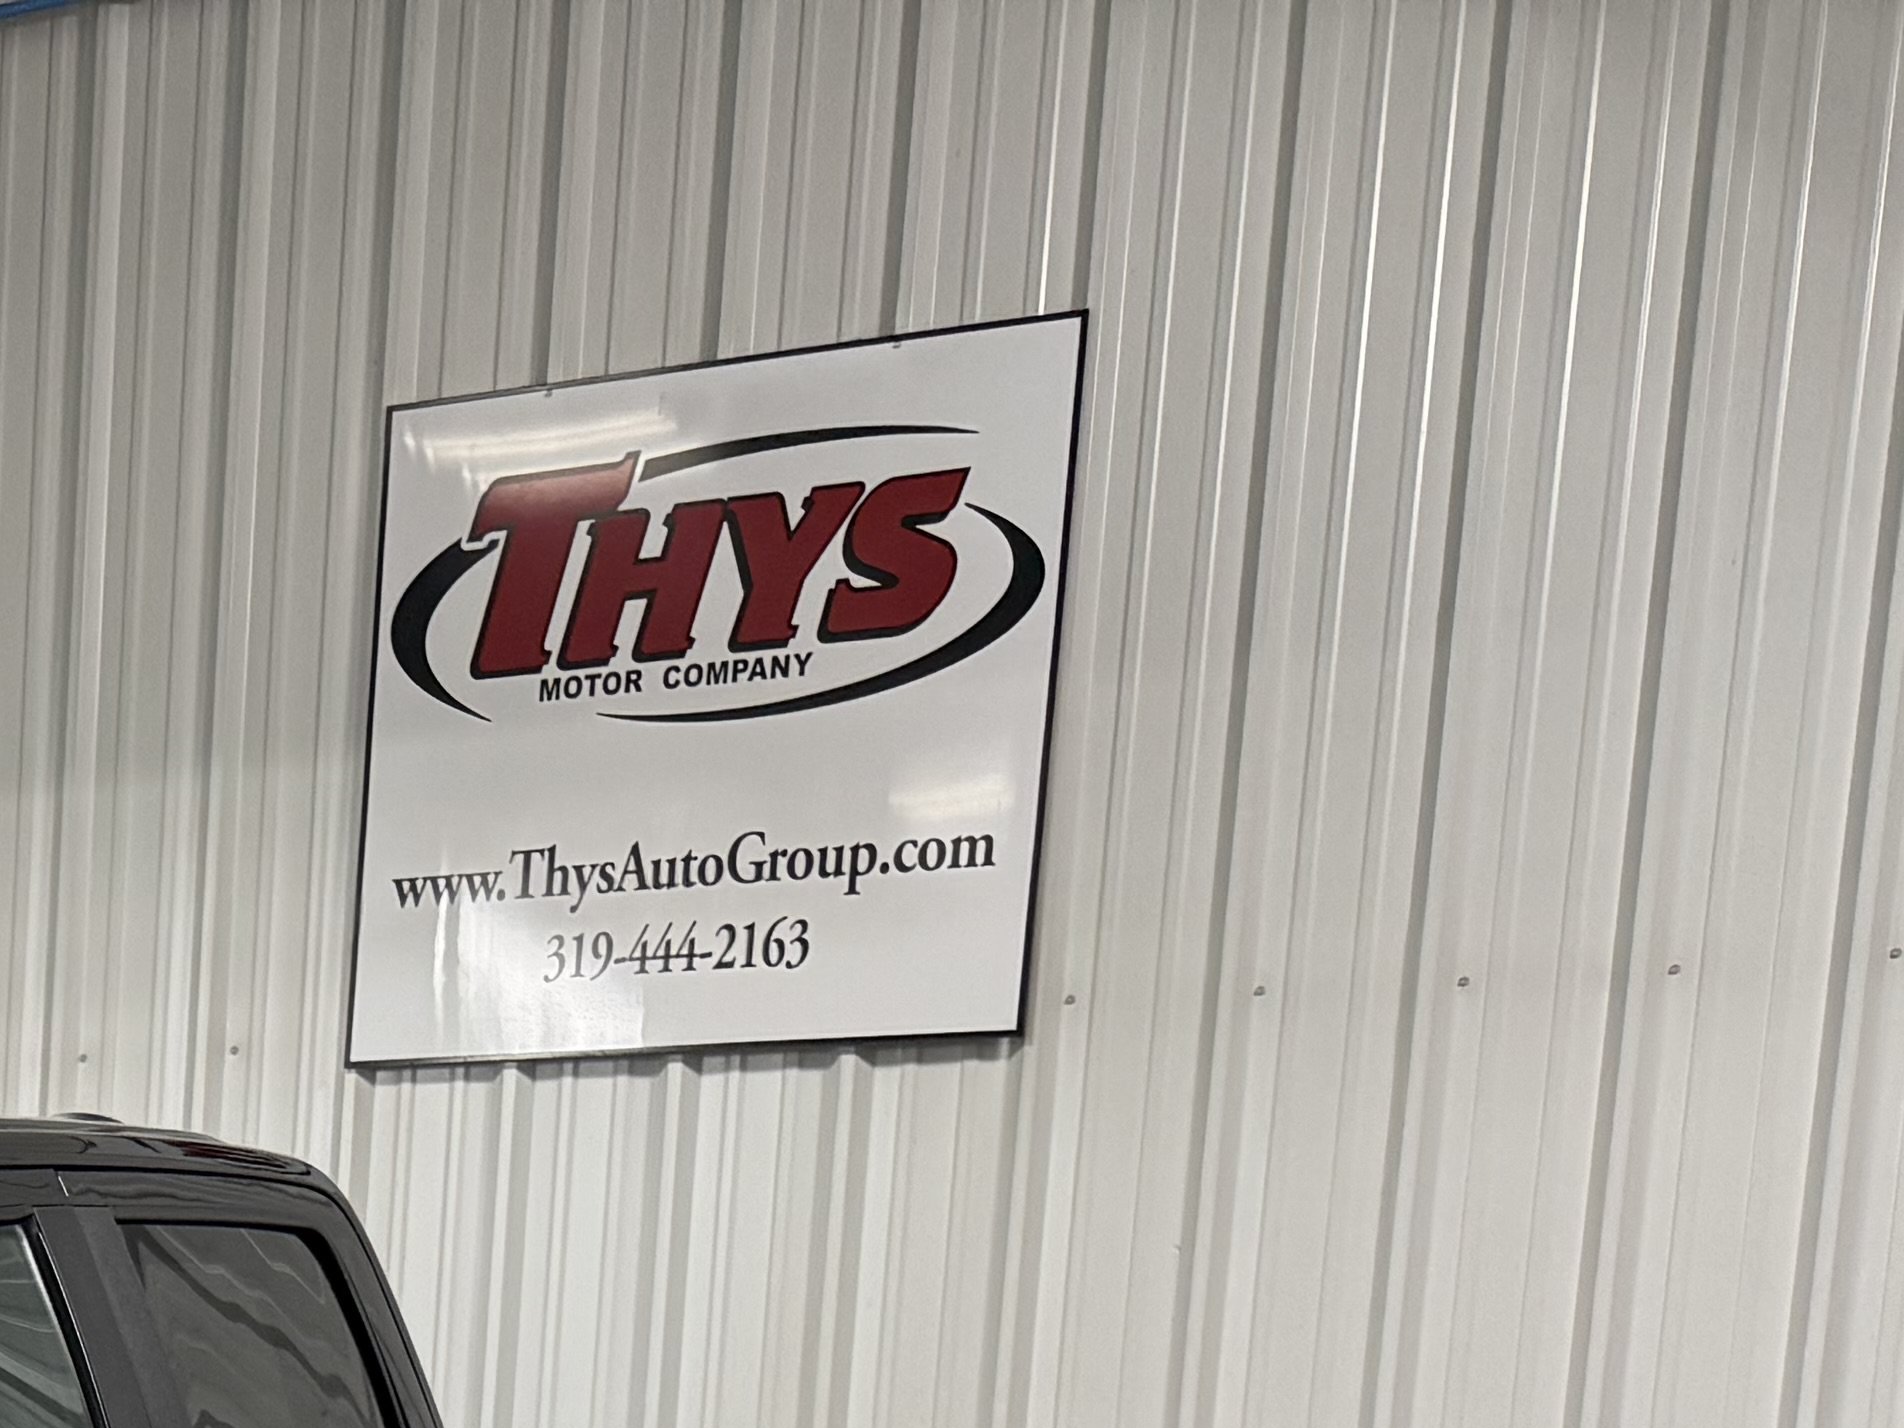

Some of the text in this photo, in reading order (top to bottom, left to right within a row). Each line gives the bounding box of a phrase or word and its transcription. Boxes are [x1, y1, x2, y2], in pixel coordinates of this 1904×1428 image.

[468, 451, 971, 679] THYS
[538, 652, 814, 702] MOTOR COMPANY
[392, 831, 996, 913] www.ThysAutoGroup.com
[543, 917, 810, 983] 319-444-2163
